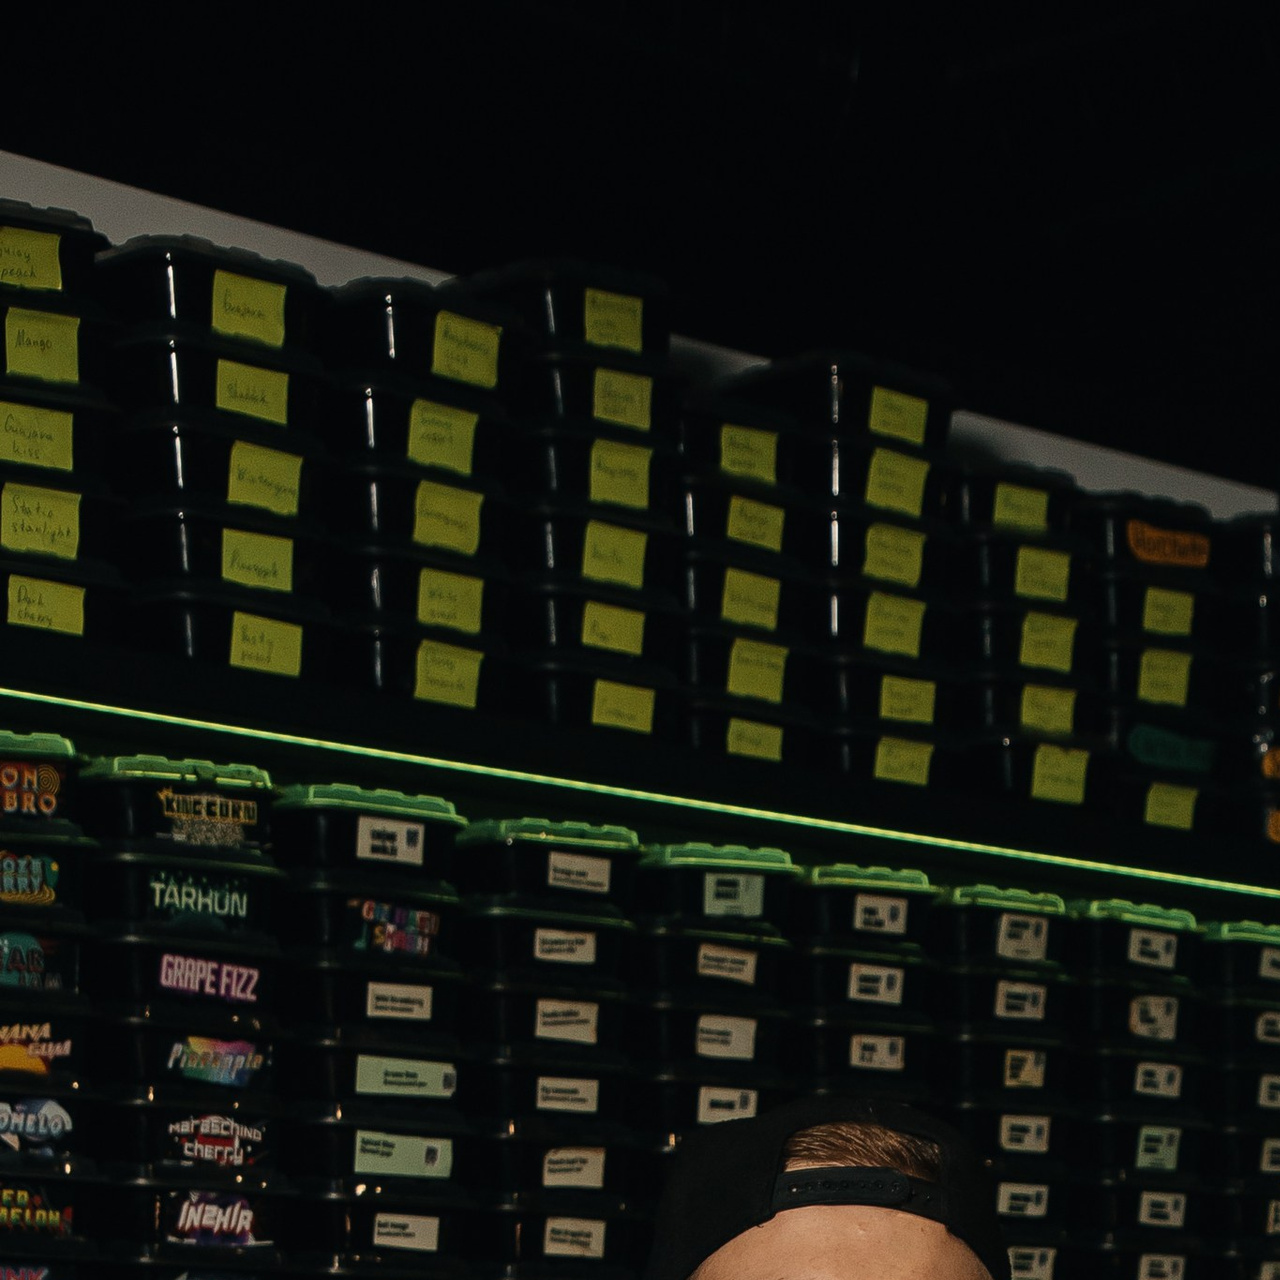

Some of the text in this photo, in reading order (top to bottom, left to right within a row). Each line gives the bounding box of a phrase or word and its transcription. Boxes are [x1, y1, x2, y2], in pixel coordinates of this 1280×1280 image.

[15, 329, 53, 352] Mango
[149, 880, 248, 919] TARHUN
[159, 953, 260, 1002] GRAPE FIZZ
